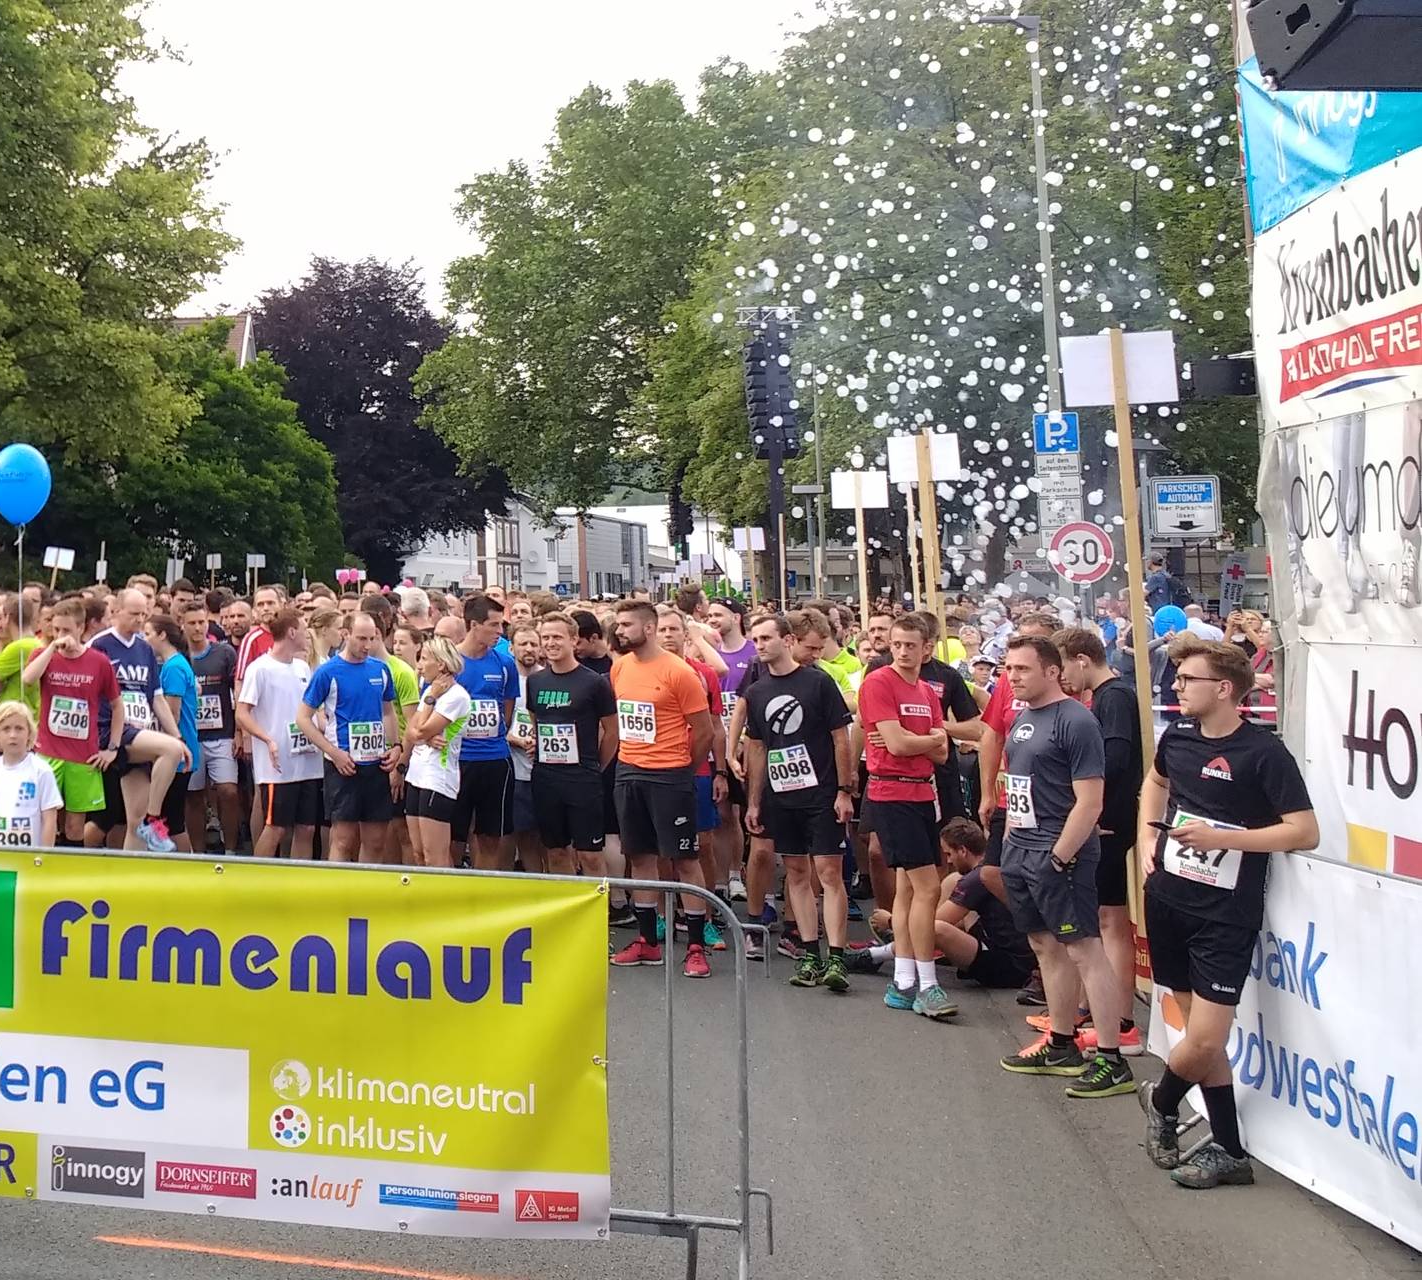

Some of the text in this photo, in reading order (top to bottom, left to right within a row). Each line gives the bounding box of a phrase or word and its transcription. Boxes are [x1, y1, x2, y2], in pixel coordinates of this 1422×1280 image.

[1278, 187, 1422, 334] Krombache
[1285, 313, 1422, 384] ALKOHOLFRE
[1158, 483, 1211, 494] PARKSCHEIN-
[1167, 493, 1203, 502] AUTOMAT
[1063, 539, 1098, 566] 30
[52, 710, 89, 729] 7308
[619, 714, 654, 732] 1656
[351, 734, 383, 751] 7802
[542, 737, 571, 753] 263
[1342, 670, 1422, 800] HO
[769, 759, 811, 781] 8098
[41, 900, 534, 1006] Firmenlauf
[89, 1060, 165, 1111] eG
[317, 1067, 535, 1115] klimaneutral
[1229, 1013, 1422, 1186] dwestfale
[317, 1116, 448, 1156] inklusiv
[66, 1157, 144, 1186] innogy
[385, 1185, 493, 1204] personalunion.siegen
[548, 1212, 570, 1220] Siegen
[557, 1206, 577, 1214] Metall
